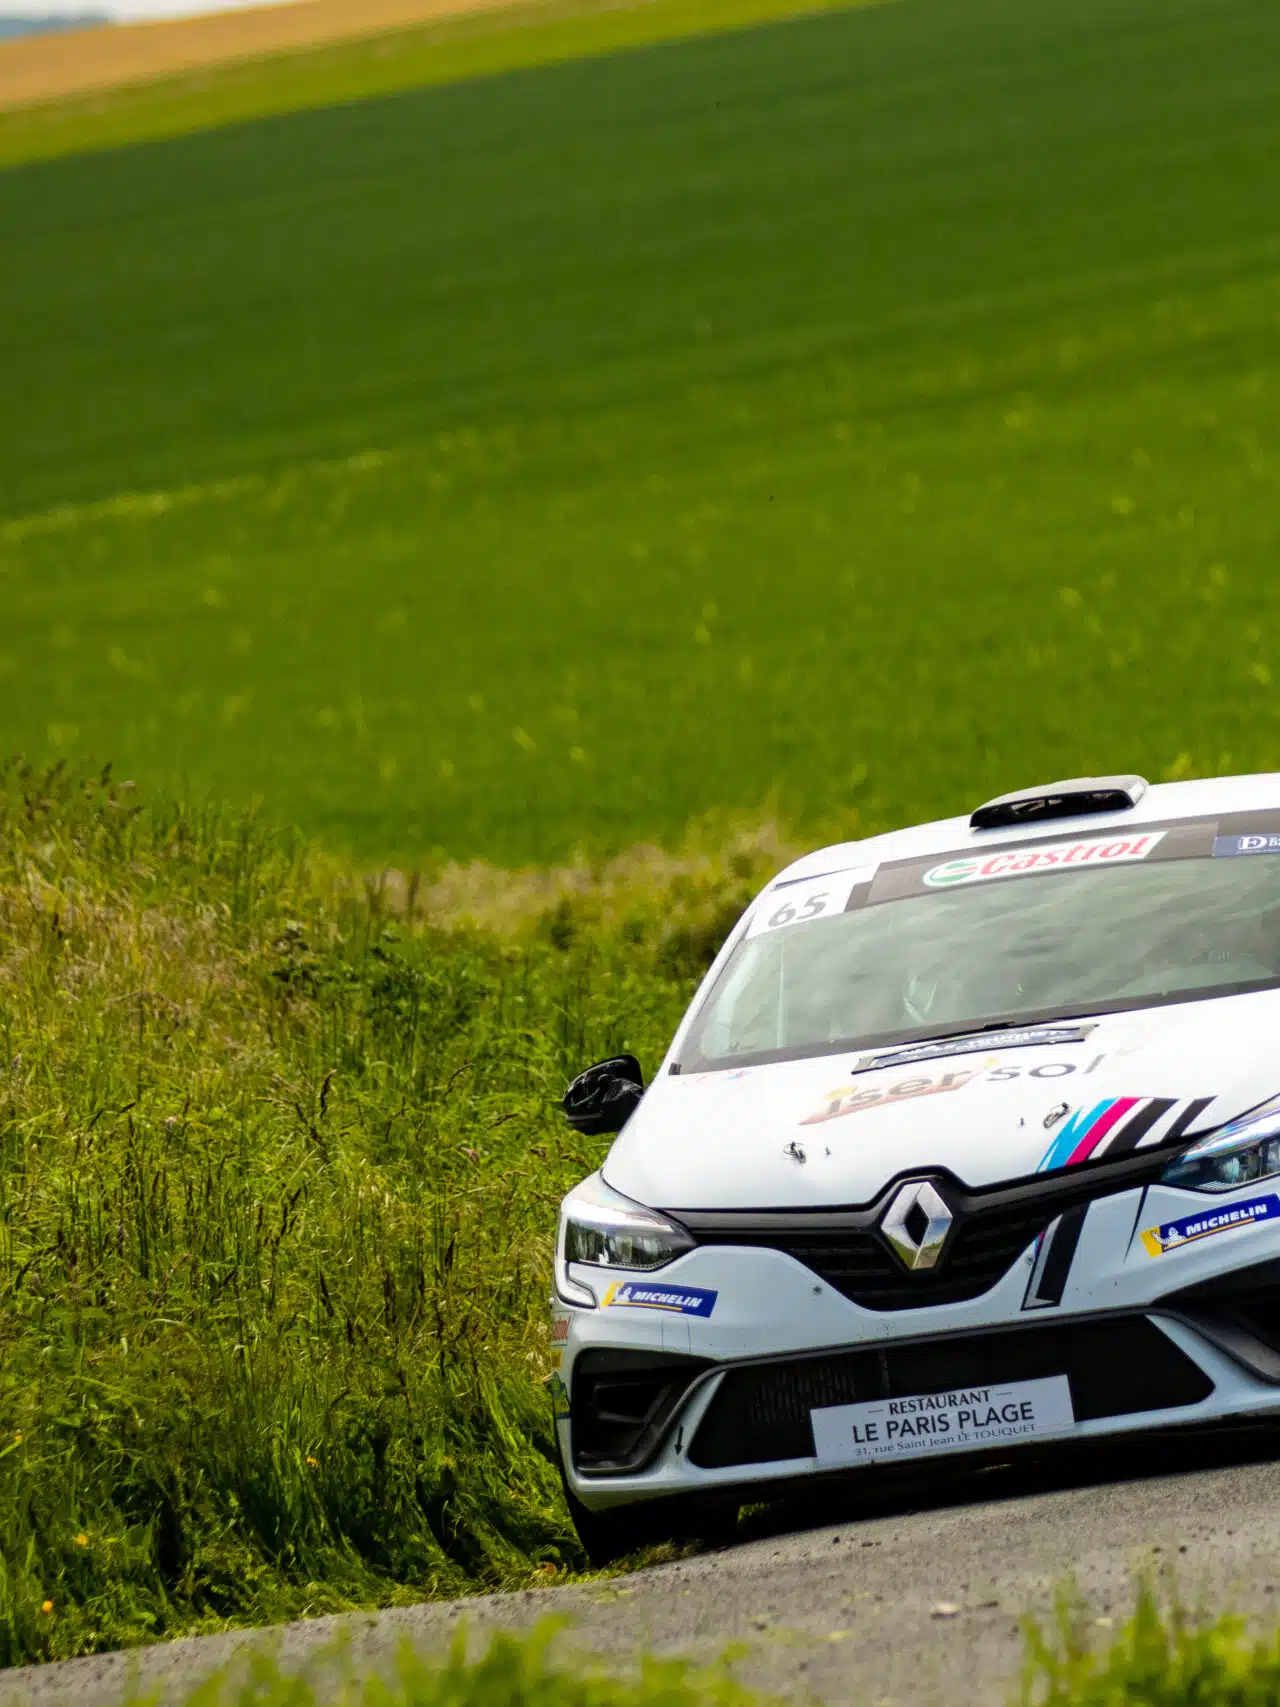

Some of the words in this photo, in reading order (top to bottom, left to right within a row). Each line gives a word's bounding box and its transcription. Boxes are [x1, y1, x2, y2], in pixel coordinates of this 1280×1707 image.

[980, 834, 1152, 877] Castrol
[767, 891, 830, 929] 65
[1185, 1203, 1268, 1236] MICHELIN
[632, 1291, 703, 1308] MICHELIN
[889, 1389, 991, 1416] RESTAURANT
[852, 1422, 879, 1444] LE
[886, 1413, 951, 1439] PARIS
[957, 1401, 1036, 1429] PLAGE
[855, 1447, 873, 1457] 31,
[874, 1443, 895, 1454] rue
[897, 1438, 926, 1451] Saint
[929, 1434, 955, 1449] Jean
[957, 1431, 973, 1443] LE
[974, 1423, 1037, 1439] TOUQUET
